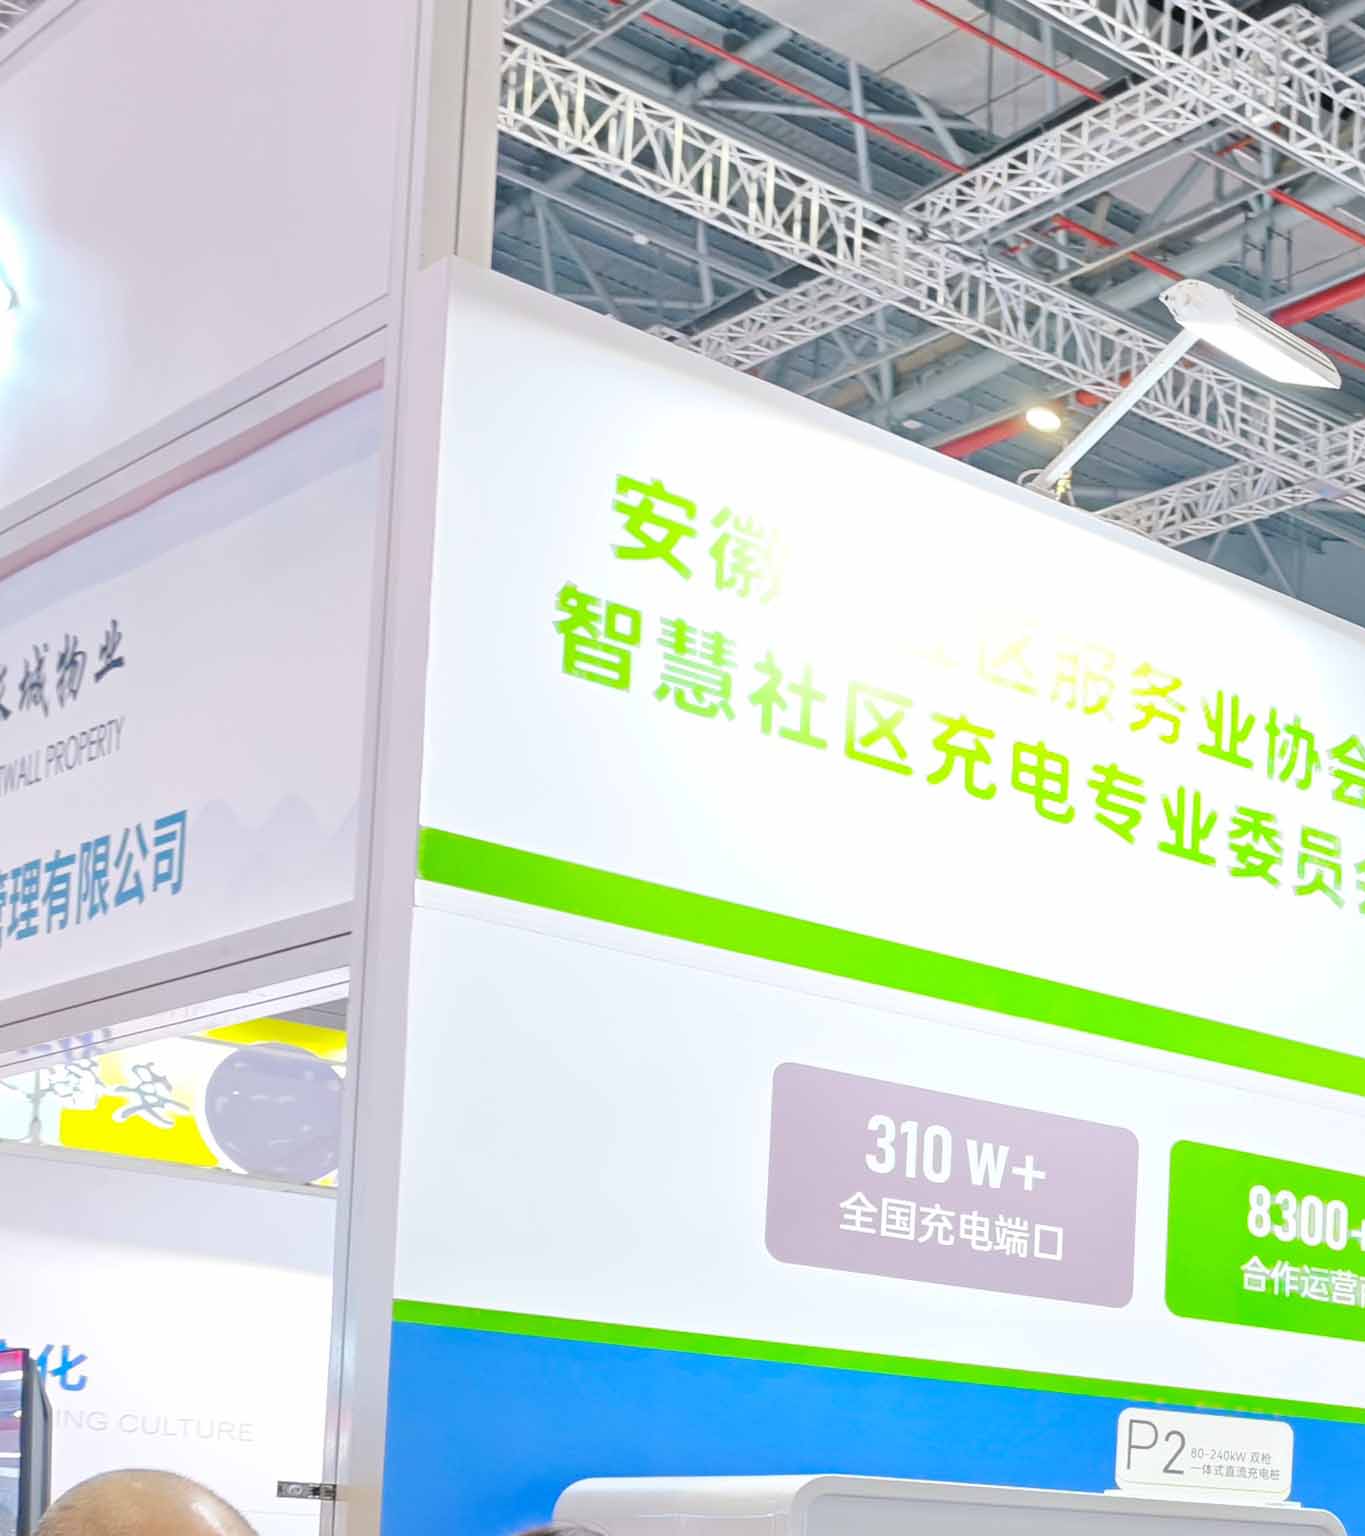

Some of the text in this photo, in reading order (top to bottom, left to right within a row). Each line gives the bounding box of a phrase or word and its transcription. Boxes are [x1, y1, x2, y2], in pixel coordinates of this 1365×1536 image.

[46, 716, 125, 779] PROPERTY
[865, 1114, 1046, 1191] 310 W+
[839, 1191, 1064, 1261] 全国充电端口
[56, 1408, 256, 1442] ING CULTURE
[1127, 1419, 1185, 1475] P2
